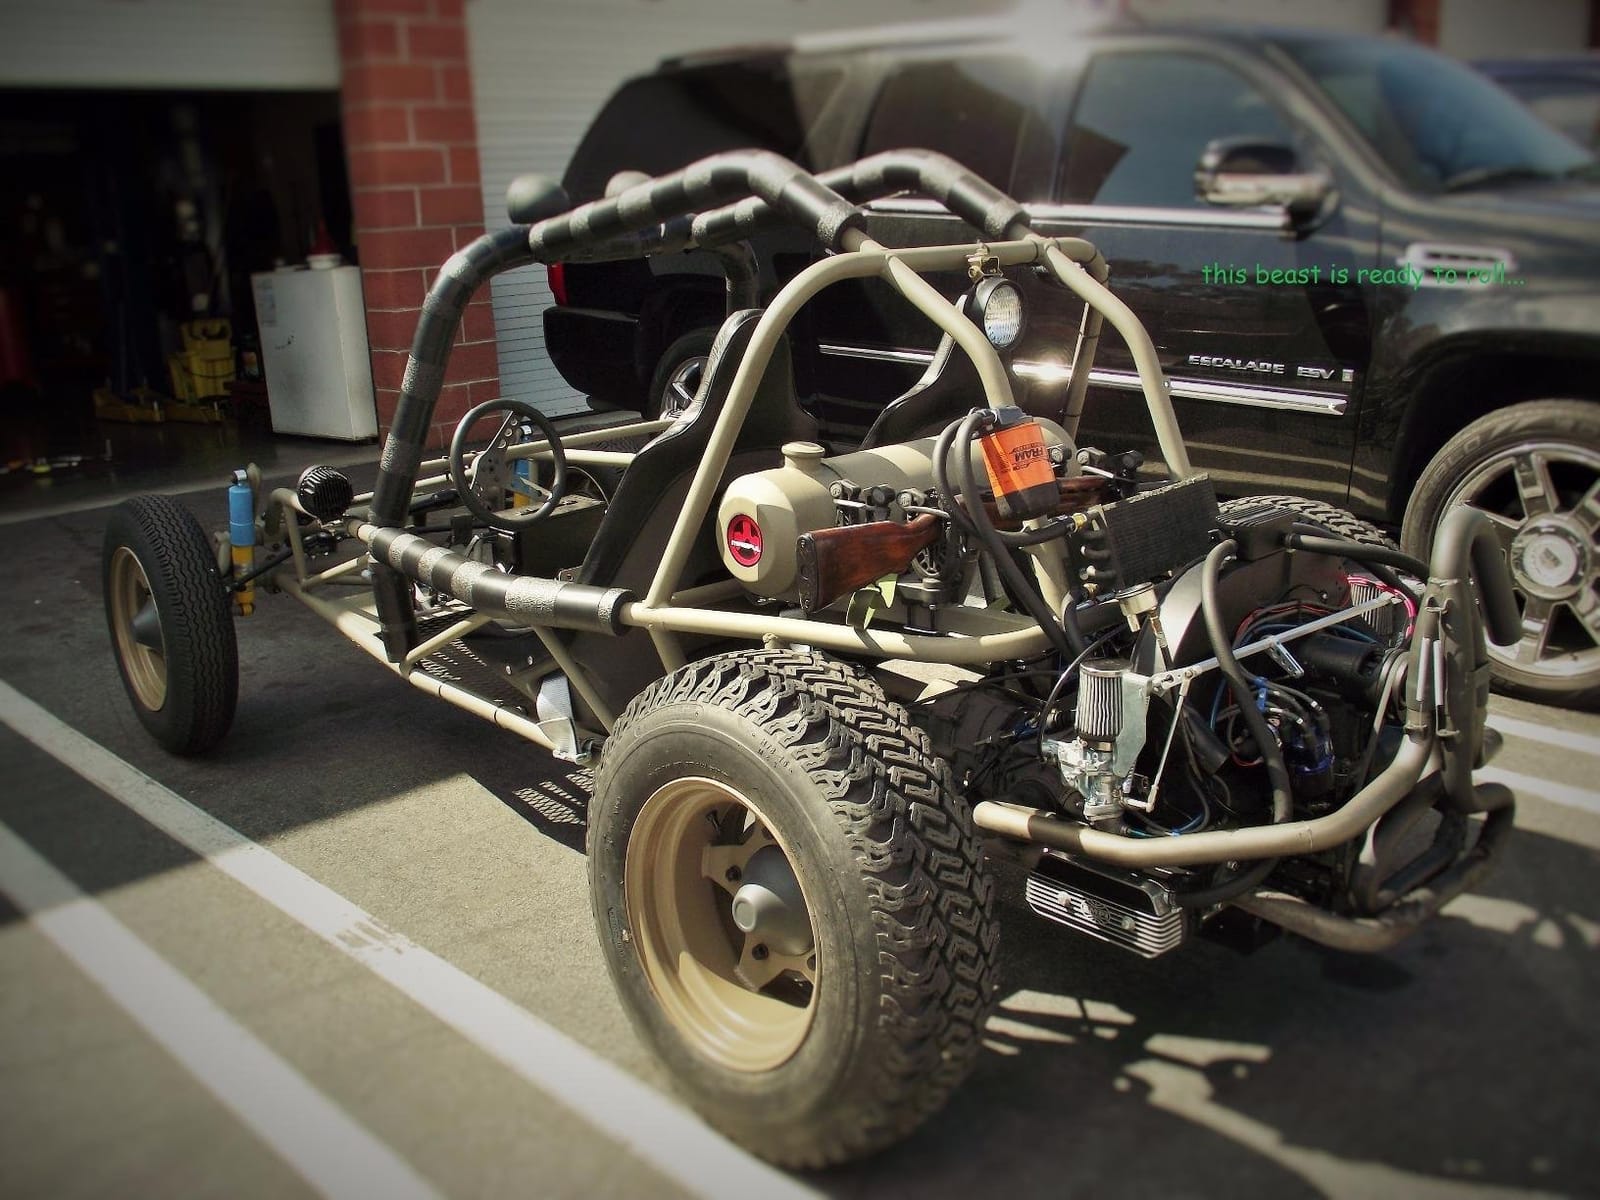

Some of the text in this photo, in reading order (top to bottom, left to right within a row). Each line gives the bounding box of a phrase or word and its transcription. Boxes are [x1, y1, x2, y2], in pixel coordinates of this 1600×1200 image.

[1188, 354, 1335, 380] ESCALADE ESV
[1014, 446, 1044, 462] FRAM
